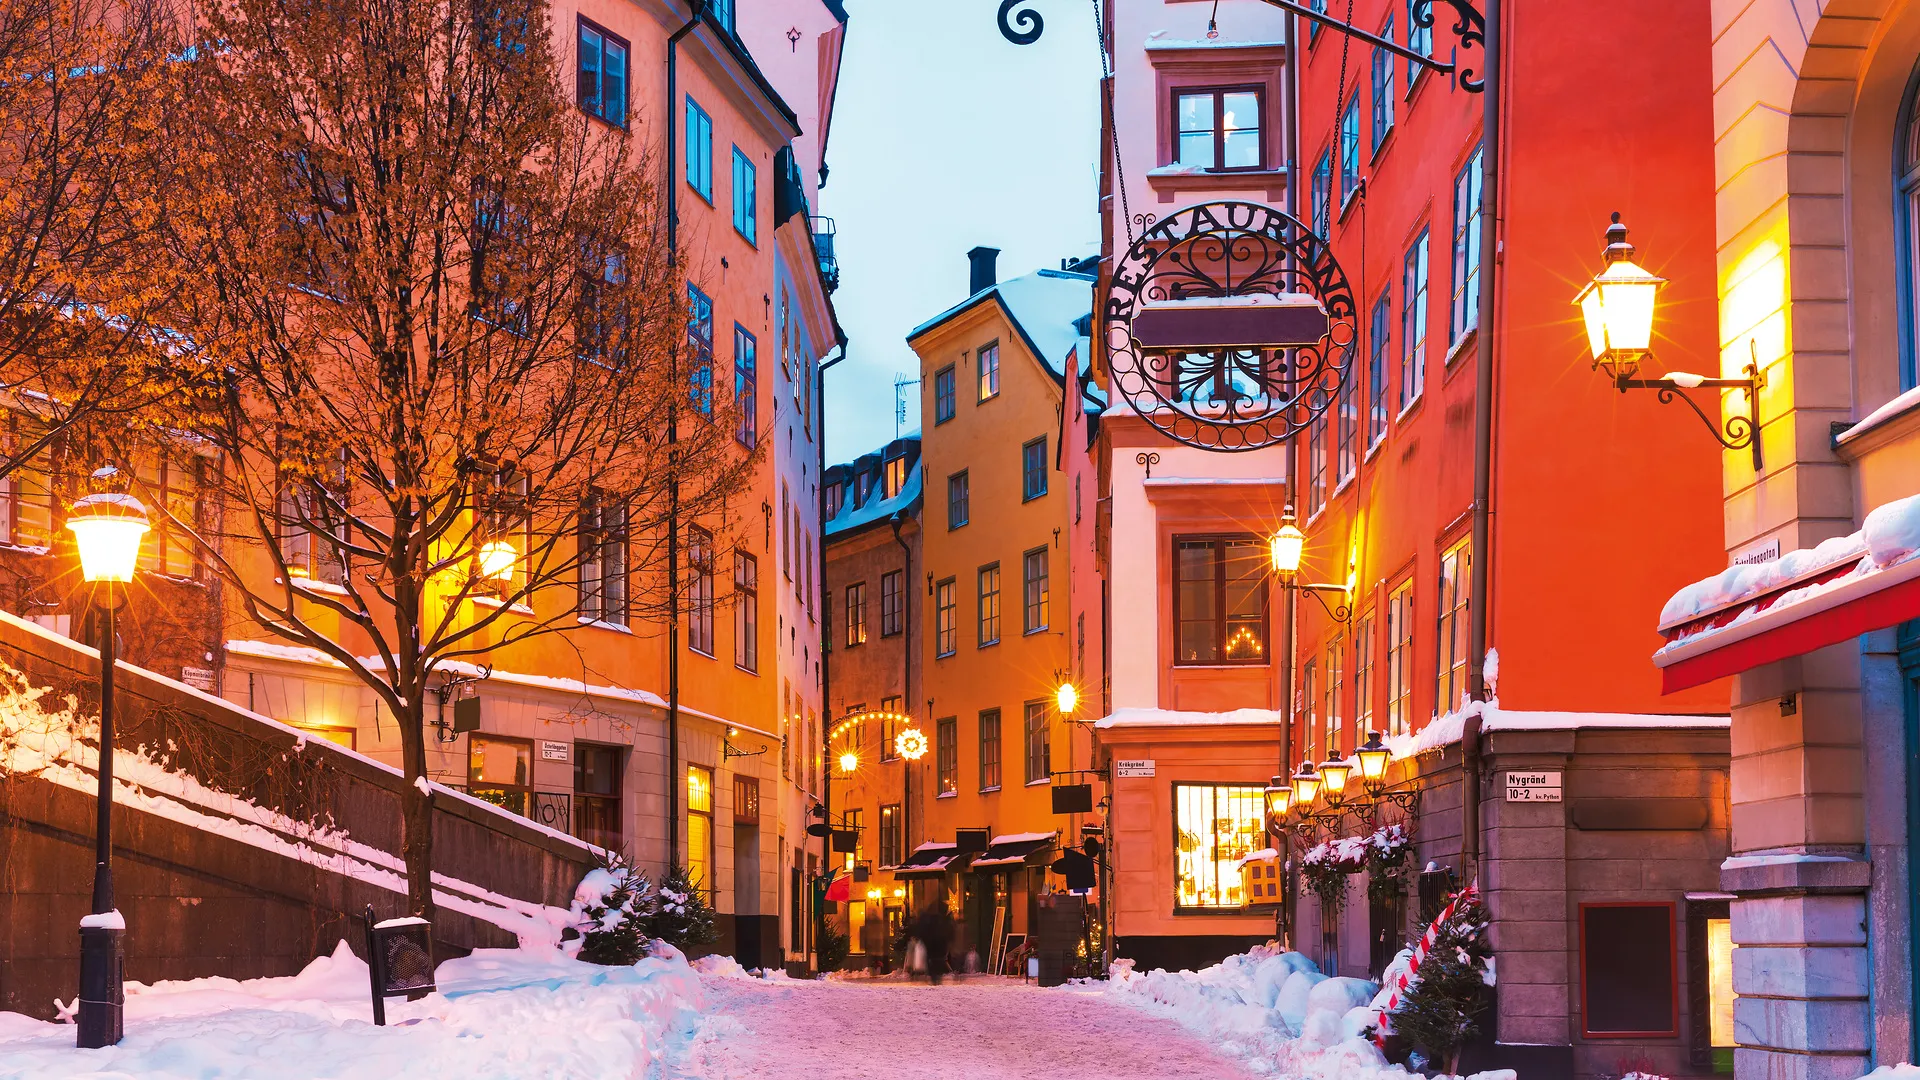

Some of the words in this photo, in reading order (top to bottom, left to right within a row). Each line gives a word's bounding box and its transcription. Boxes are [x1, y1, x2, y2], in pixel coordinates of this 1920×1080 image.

[1106, 203, 1355, 325] RESTAURANG
[1118, 761, 1145, 769] Kråkgränd
[1509, 775, 1546, 786] Nygränd
[1509, 789, 1530, 799] 10-2
